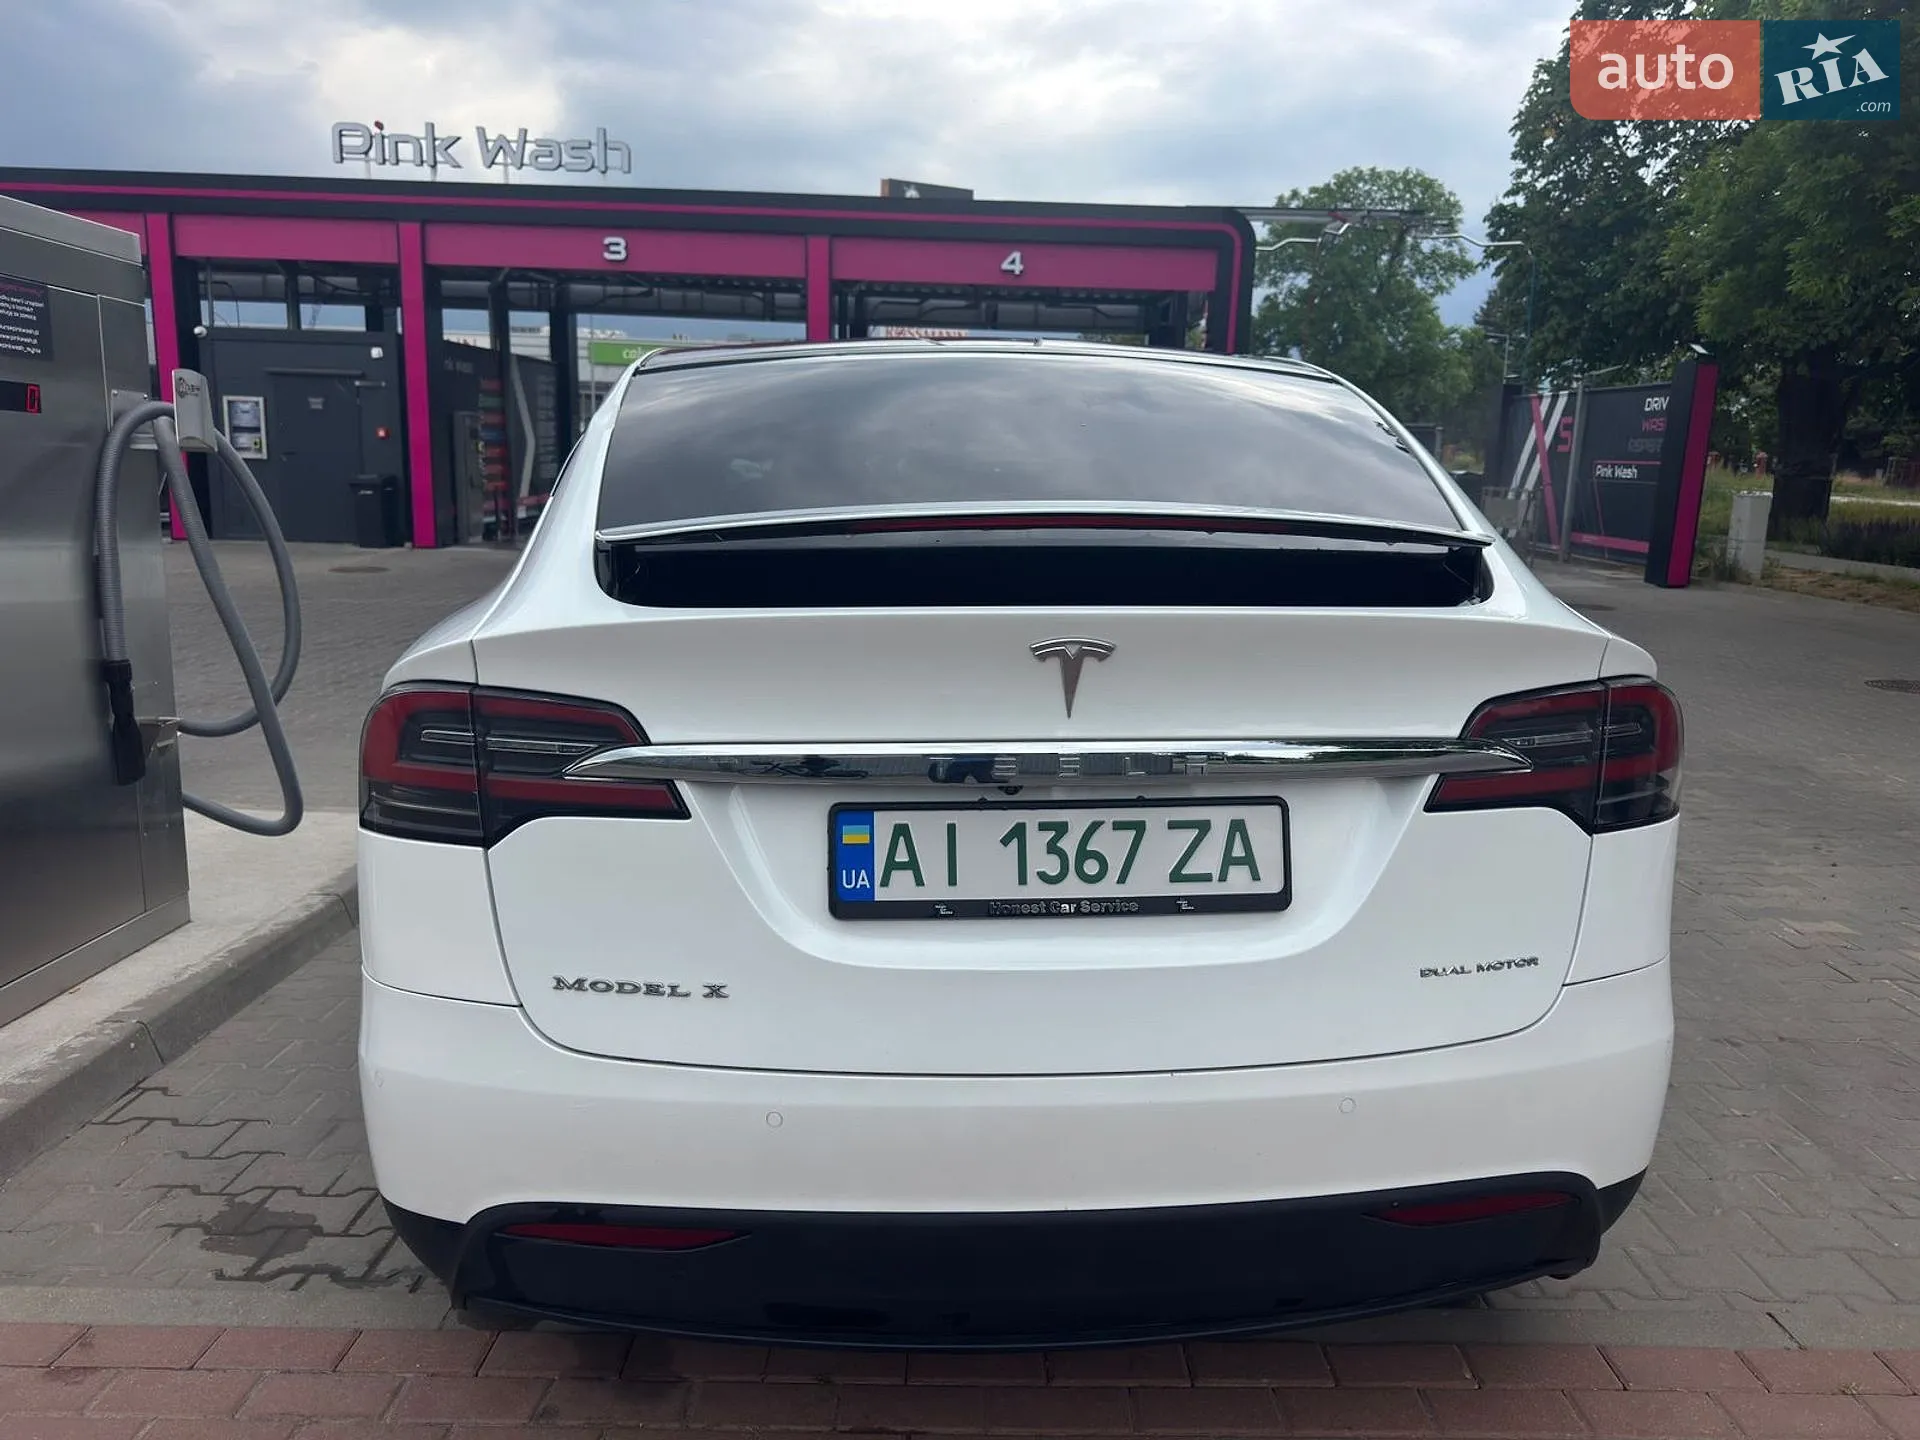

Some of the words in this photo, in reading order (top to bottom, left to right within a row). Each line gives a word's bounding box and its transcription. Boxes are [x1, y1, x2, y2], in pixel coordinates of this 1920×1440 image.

[331, 120, 464, 168] Pink
[475, 126, 633, 174] Wash
[603, 236, 628, 261] 3
[1001, 250, 1024, 276] 4
[1644, 396, 1670, 412] DRIV
[1641, 417, 1668, 433] WAS
[1595, 464, 1613, 478] Pink
[1614, 465, 1638, 479] Wash
[879, 822, 958, 888] AI
[999, 820, 1147, 886] 1367
[1167, 818, 1262, 884] ZA
[842, 869, 871, 889] UA
[989, 900, 1047, 915] Honest
[1050, 900, 1077, 914] Car
[1079, 899, 1139, 914] Service
[1420, 965, 1472, 978] DUAL
[1476, 956, 1539, 973] MOTOR
[552, 975, 692, 998] MODEL
[702, 983, 730, 999] X
